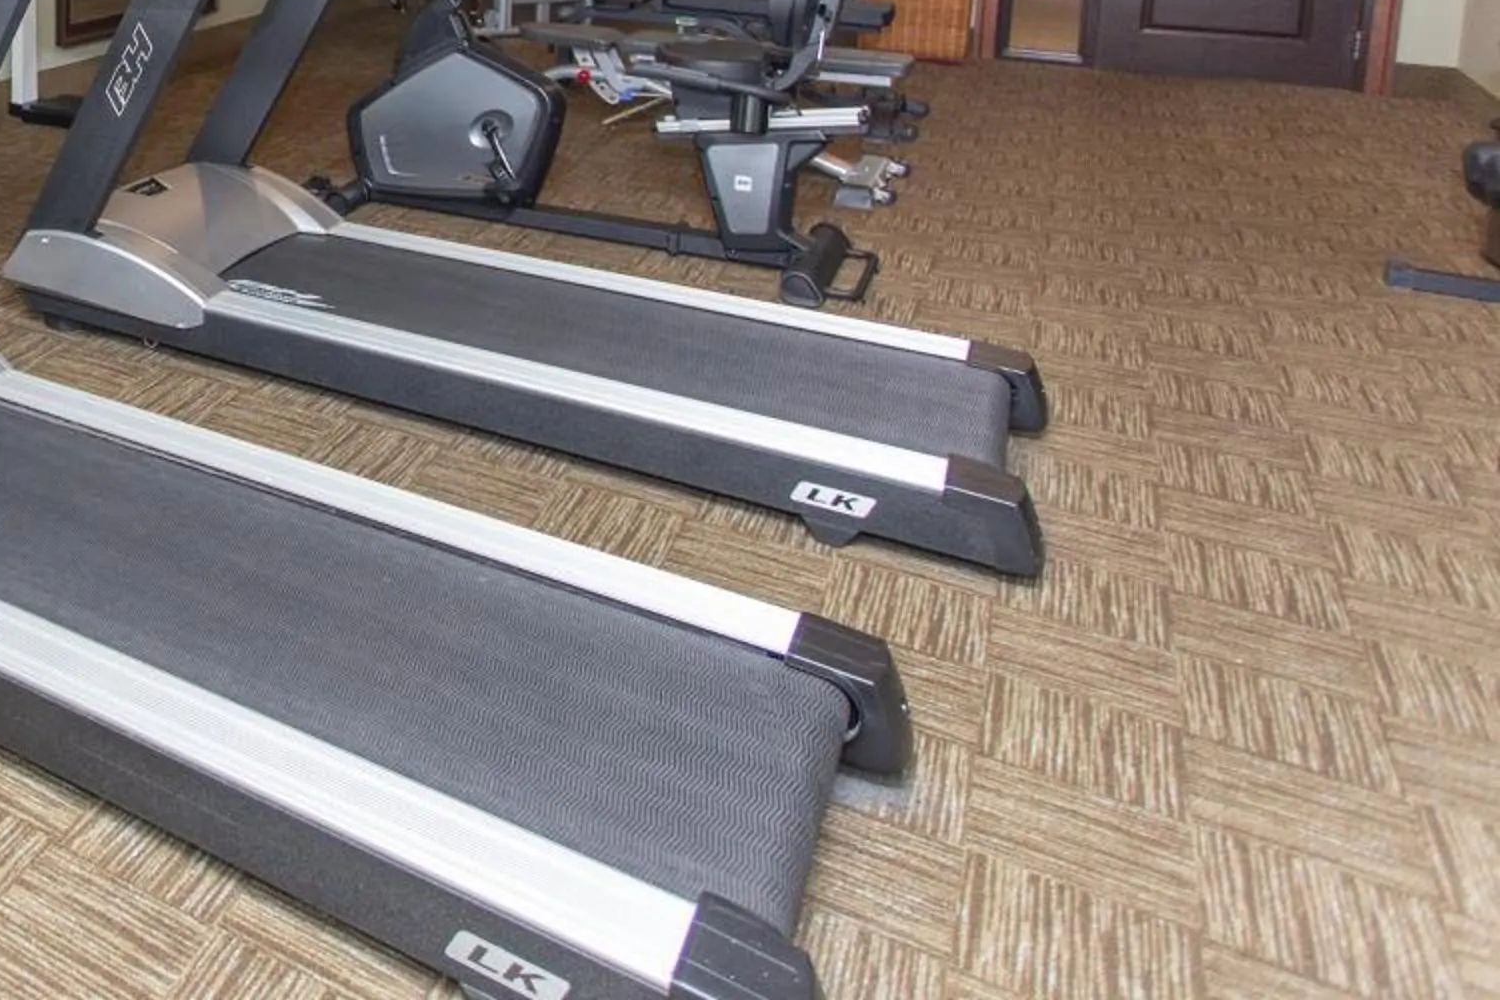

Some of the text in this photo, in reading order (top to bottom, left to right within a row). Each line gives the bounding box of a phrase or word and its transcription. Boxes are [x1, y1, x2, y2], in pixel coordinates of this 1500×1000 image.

[105, 21, 153, 116] BH
[806, 488, 858, 511] LK
[468, 944, 548, 995] LK
